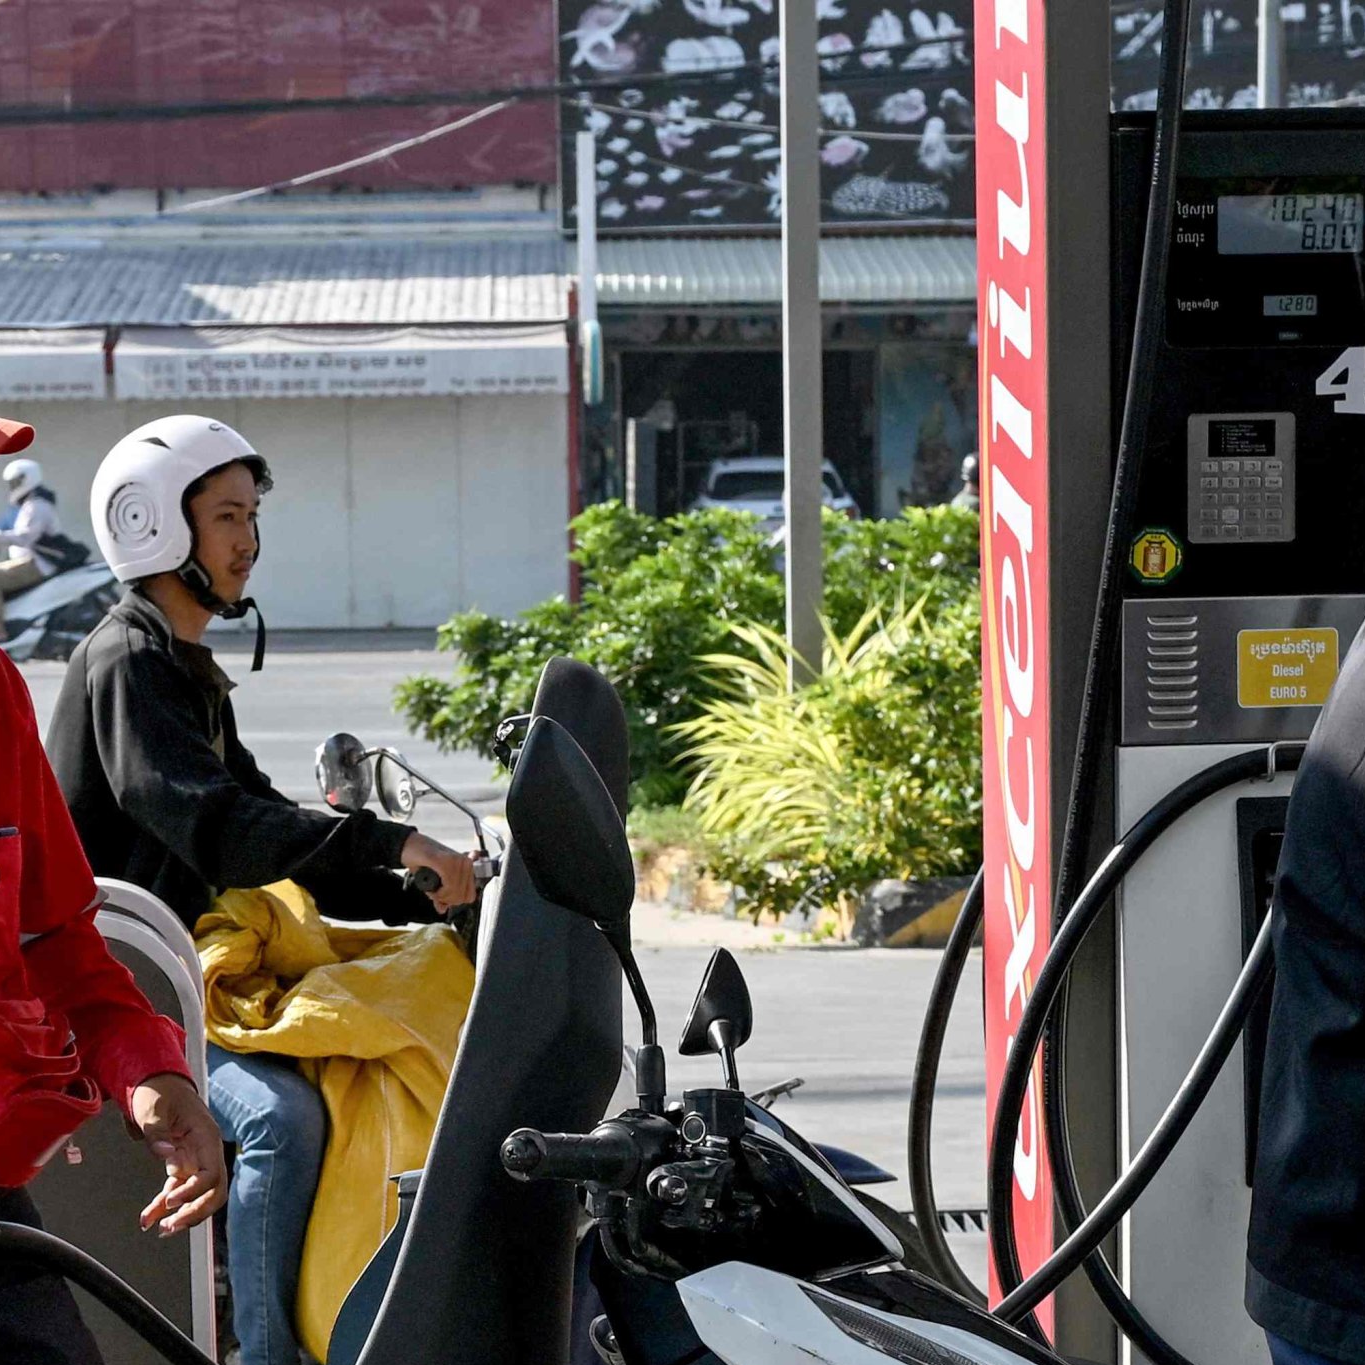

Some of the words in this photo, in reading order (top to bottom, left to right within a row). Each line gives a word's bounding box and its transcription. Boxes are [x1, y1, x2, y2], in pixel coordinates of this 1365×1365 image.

[1301, 223, 1357, 250] 8.00
[1272, 664, 1304, 677] Diesel
[1270, 686, 1297, 699] EURO
[1299, 686, 1307, 698] 5
